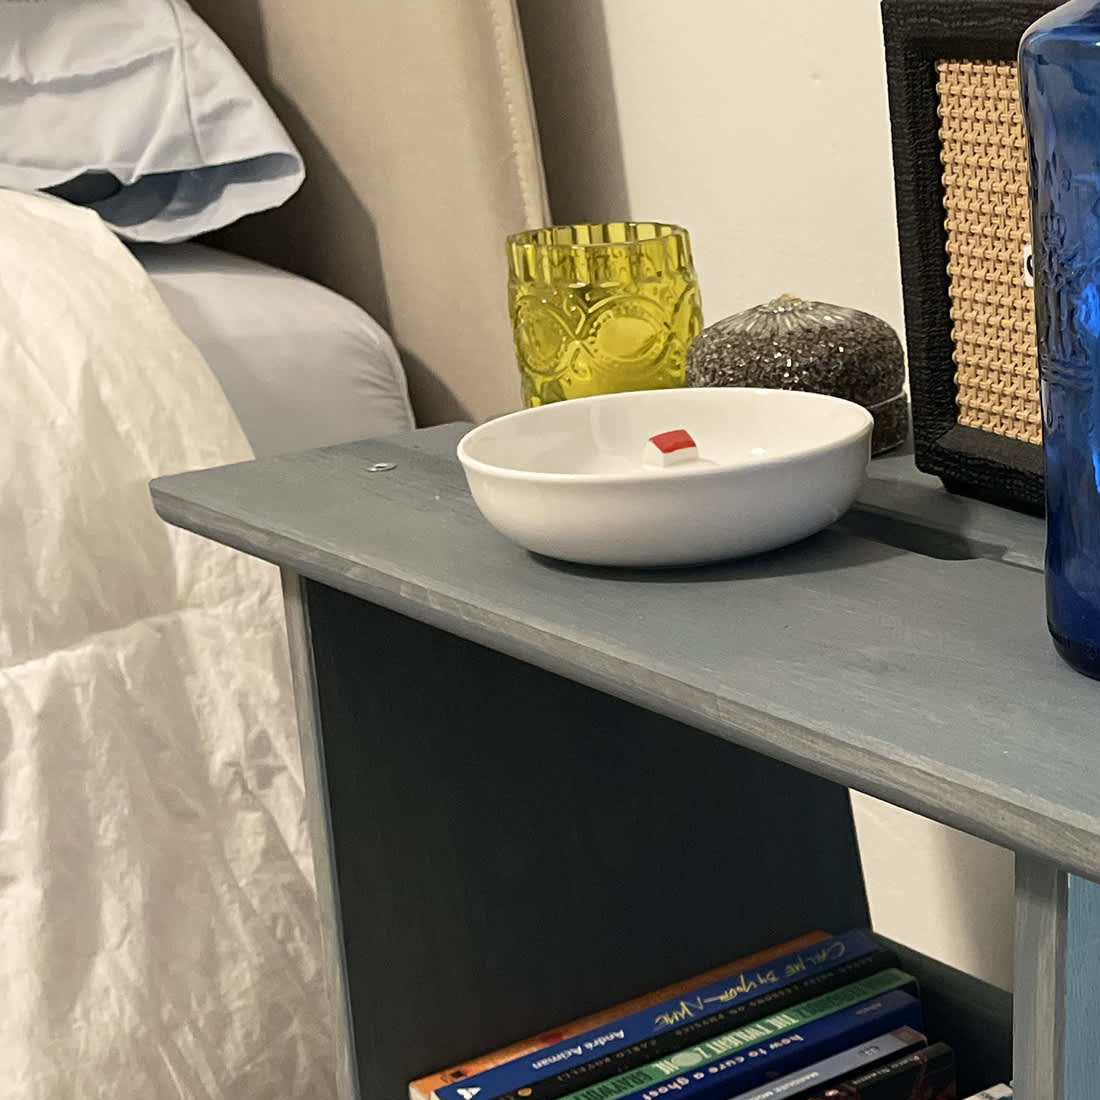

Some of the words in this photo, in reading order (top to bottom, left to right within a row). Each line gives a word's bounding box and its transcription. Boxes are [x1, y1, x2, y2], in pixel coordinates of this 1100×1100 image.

[766, 1013, 800, 1030] THE
[583, 1029, 625, 1050] André
[706, 1023, 775, 1055] TWILIGHT
[769, 1034, 805, 1050] how
[532, 1045, 583, 1069] Aciman
[652, 1047, 713, 1075] ZONE
[748, 1047, 768, 1058] to
[708, 1056, 745, 1074] cure
[692, 1071, 705, 1080] a
[642, 1076, 690, 1100] ghost
